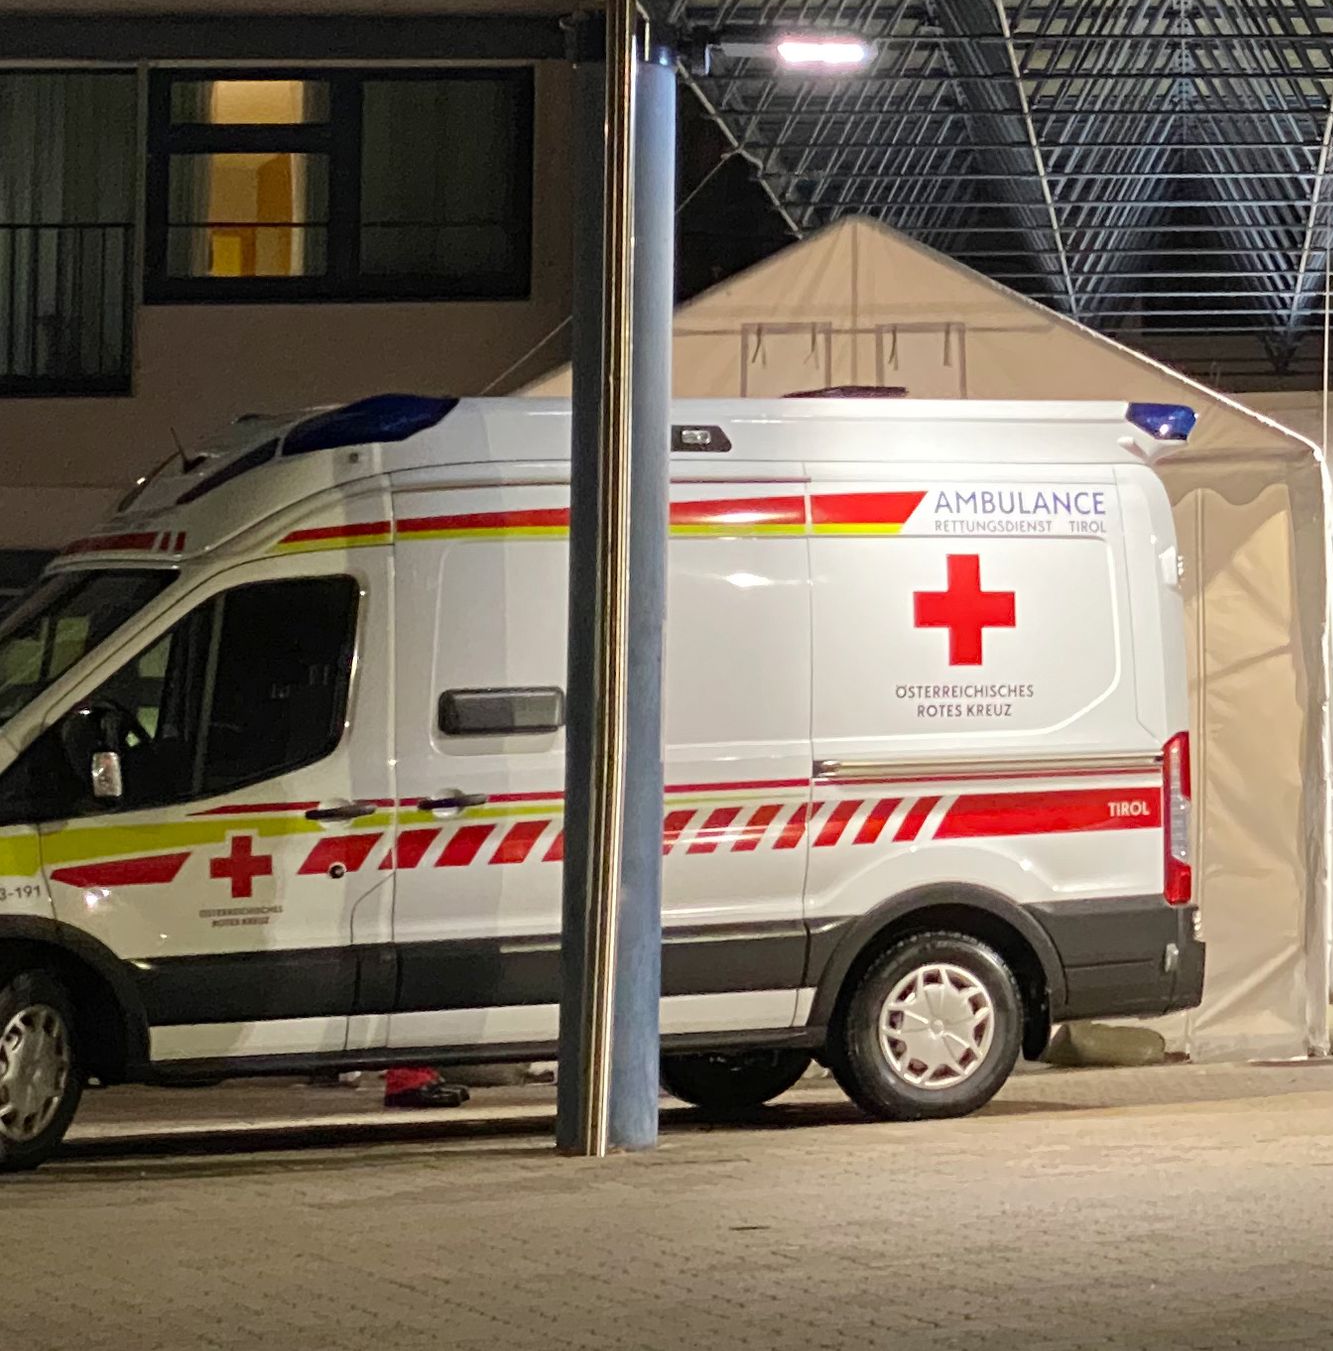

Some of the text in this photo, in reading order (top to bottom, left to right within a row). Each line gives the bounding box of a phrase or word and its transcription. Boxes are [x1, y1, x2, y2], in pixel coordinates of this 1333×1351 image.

[934, 491, 1106, 515] AMBULANCE
[935, 520, 1106, 533] RETTUNGSDIENST TIROL
[895, 684, 1034, 699] ÖSTERREICHISCHES
[917, 704, 1012, 718] ROTES KREUZ
[1107, 800, 1150, 817] TIROL
